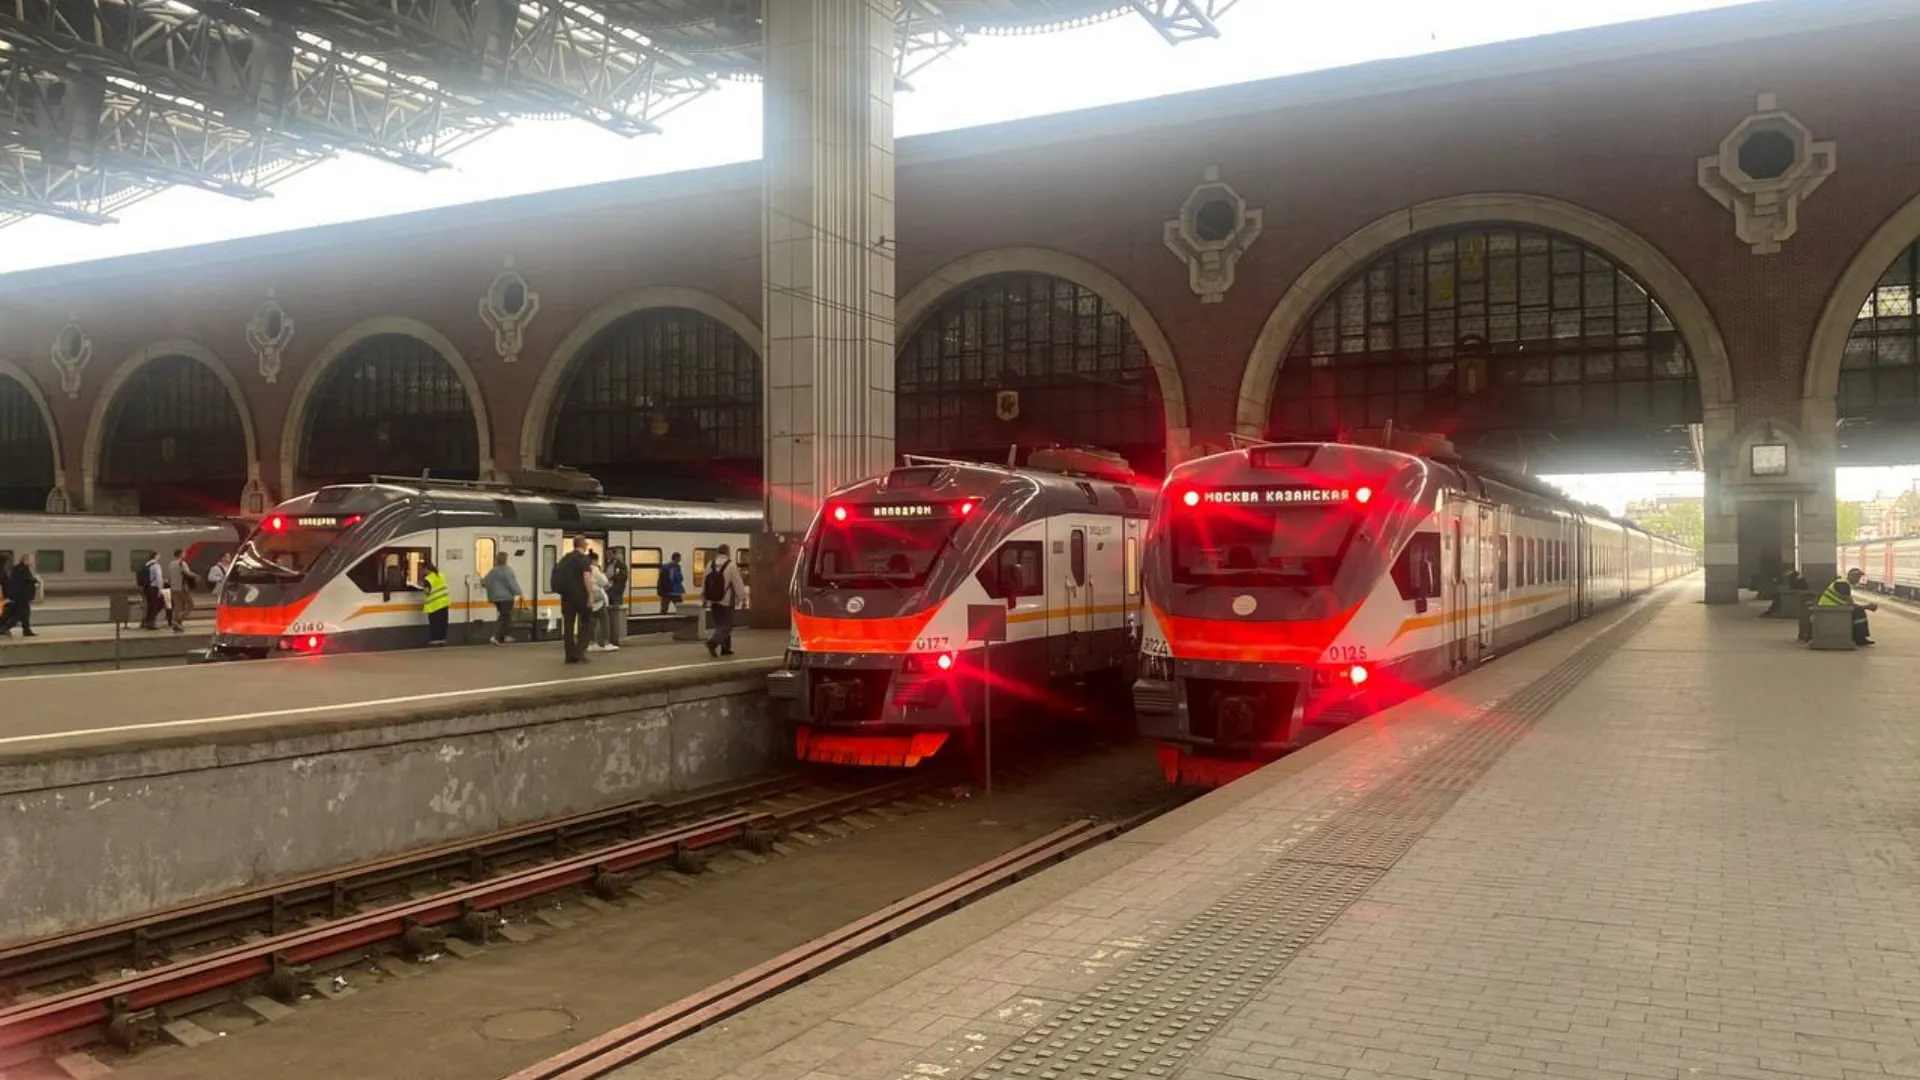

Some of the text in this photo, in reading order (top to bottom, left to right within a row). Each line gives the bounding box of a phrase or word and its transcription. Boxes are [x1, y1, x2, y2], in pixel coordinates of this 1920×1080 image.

[1204, 489, 1350, 503] МОСКВА КАЗАНСКАЯ
[916, 637, 949, 650] 0177
[1330, 645, 1368, 661] 0125
